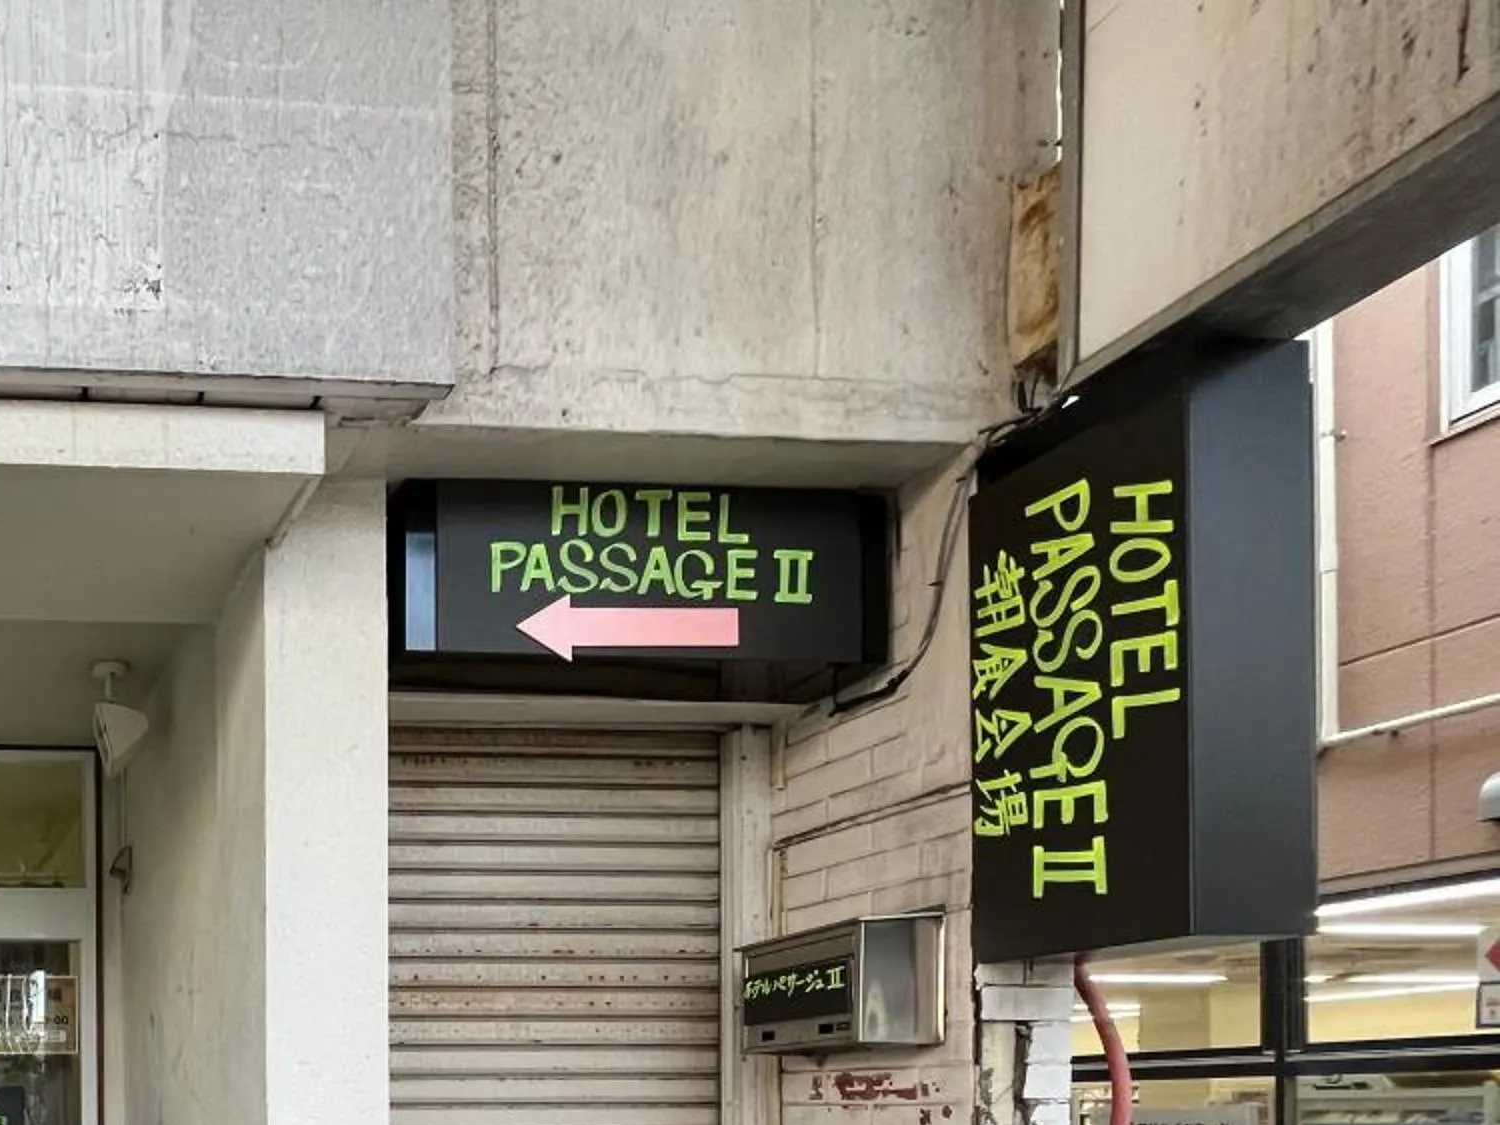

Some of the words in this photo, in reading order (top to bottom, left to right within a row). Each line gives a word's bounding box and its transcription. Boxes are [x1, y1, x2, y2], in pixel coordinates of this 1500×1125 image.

[489, 539, 759, 601] PASSAGE
[550, 485, 750, 544] HOTEL
[1109, 480, 1181, 739] HOTEL
[973, 549, 1033, 837] 朝食会場
[1024, 478, 1109, 829] PASSAGE
